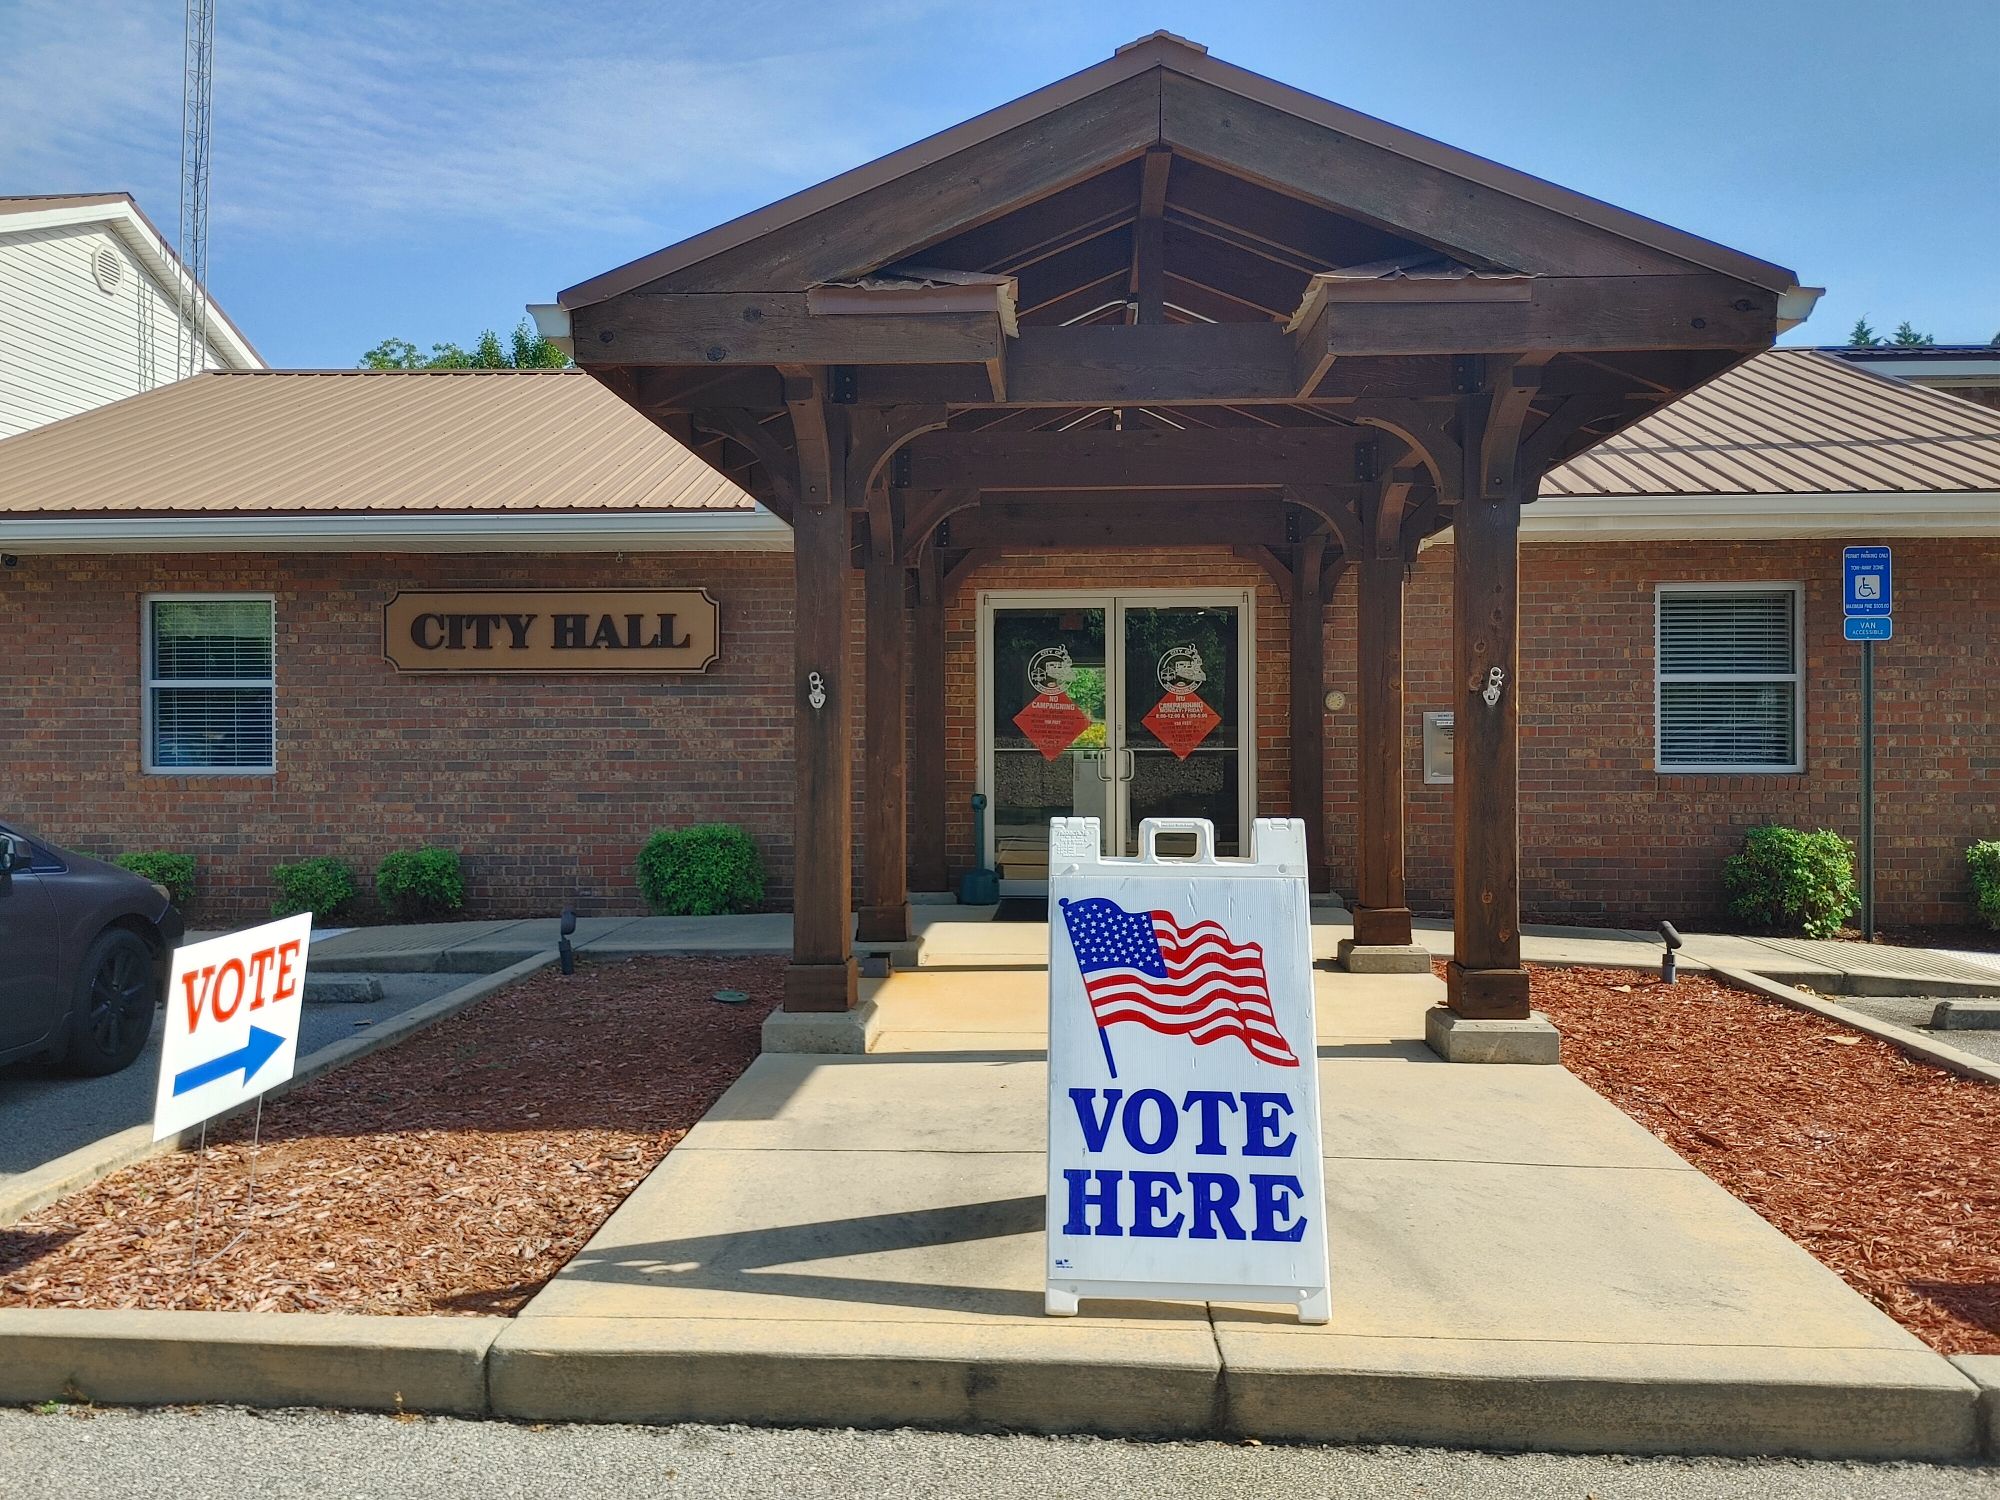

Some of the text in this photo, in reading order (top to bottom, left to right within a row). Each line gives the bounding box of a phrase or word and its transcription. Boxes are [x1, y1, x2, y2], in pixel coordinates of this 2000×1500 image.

[410, 613, 691, 650] CITY HALL
[1031, 701, 1075, 711] CAMPAIGNING
[182, 939, 301, 1035] VOTE
[1069, 1088, 1298, 1158] VOTE
[1062, 1169, 1308, 1243] HERE
